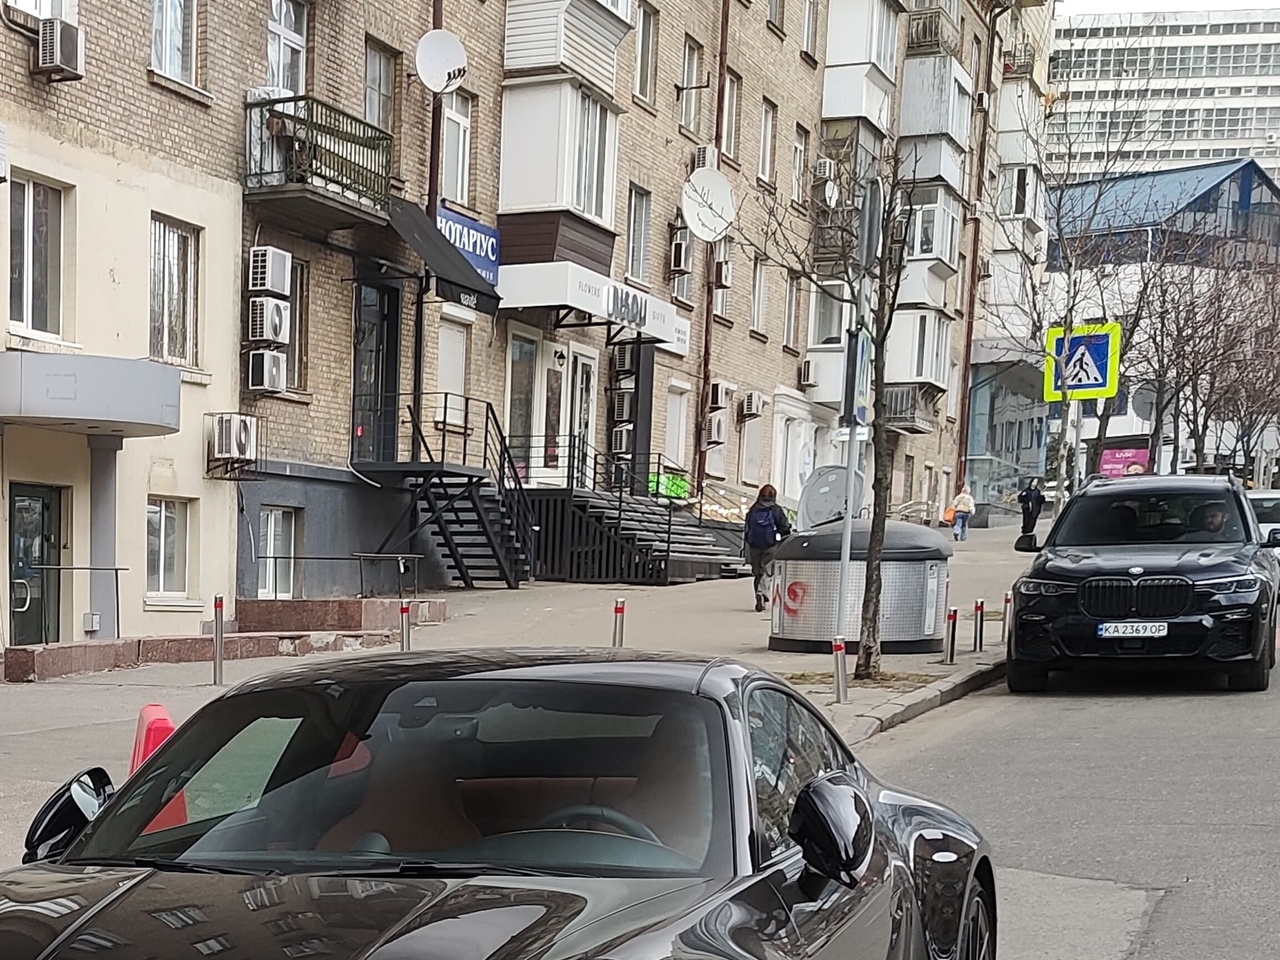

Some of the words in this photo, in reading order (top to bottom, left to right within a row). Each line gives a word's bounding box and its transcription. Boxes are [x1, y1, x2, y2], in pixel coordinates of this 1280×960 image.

[436, 215, 497, 262] НОТАРІУС
[1104, 624, 1120, 635] KA
[1122, 624, 1148, 635] 2369
[1150, 624, 1166, 635] OP
